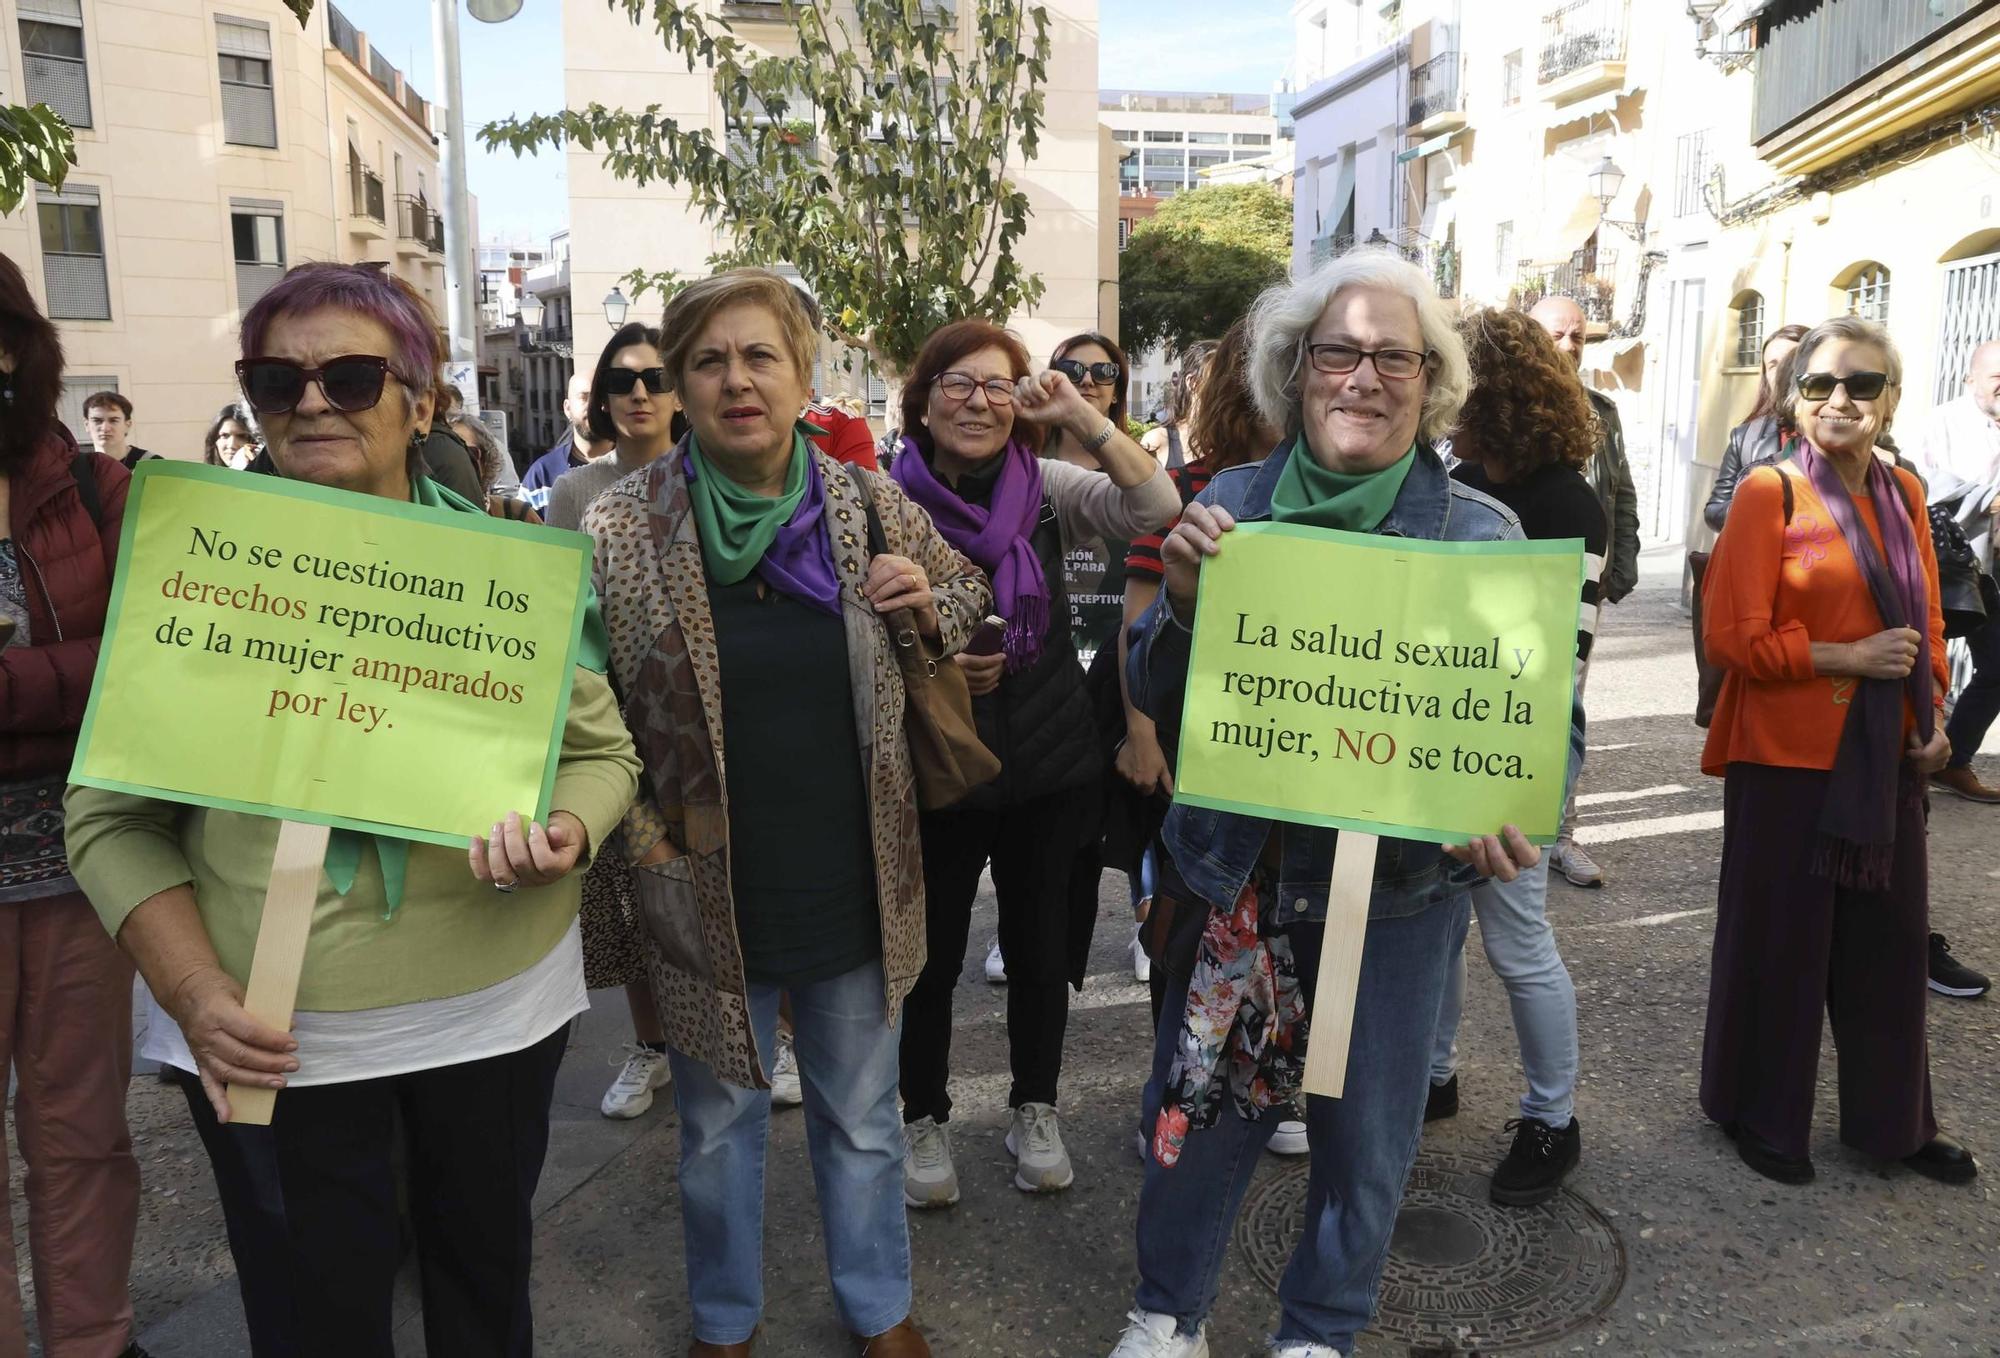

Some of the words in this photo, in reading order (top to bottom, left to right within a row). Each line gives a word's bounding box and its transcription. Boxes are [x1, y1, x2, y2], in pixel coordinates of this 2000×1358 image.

[187, 527, 237, 561] No
[248, 545, 283, 569] se
[293, 554, 465, 603] cuestionan
[486, 579, 529, 614] los
[1073, 562, 1106, 572] PARA
[162, 570, 308, 621] derechos
[317, 604, 537, 661] reproductivos
[1234, 612, 1278, 648] La
[1290, 624, 1383, 662] salud
[1394, 637, 1499, 670] sexual
[1510, 647, 1534, 680] y
[155, 616, 193, 648] de
[203, 622, 232, 654] la
[242, 638, 344, 674] mujer
[351, 657, 525, 704] amparados
[265, 688, 328, 718] por
[336, 692, 395, 734] ley.
[1223, 671, 1441, 719] reproductiva
[1452, 687, 1490, 722] de
[1501, 689, 1534, 726] la
[1210, 719, 1319, 762] mujer,
[1332, 727, 1396, 766] NO
[1408, 746, 1441, 771] se
[1452, 744, 1534, 780] toca.
